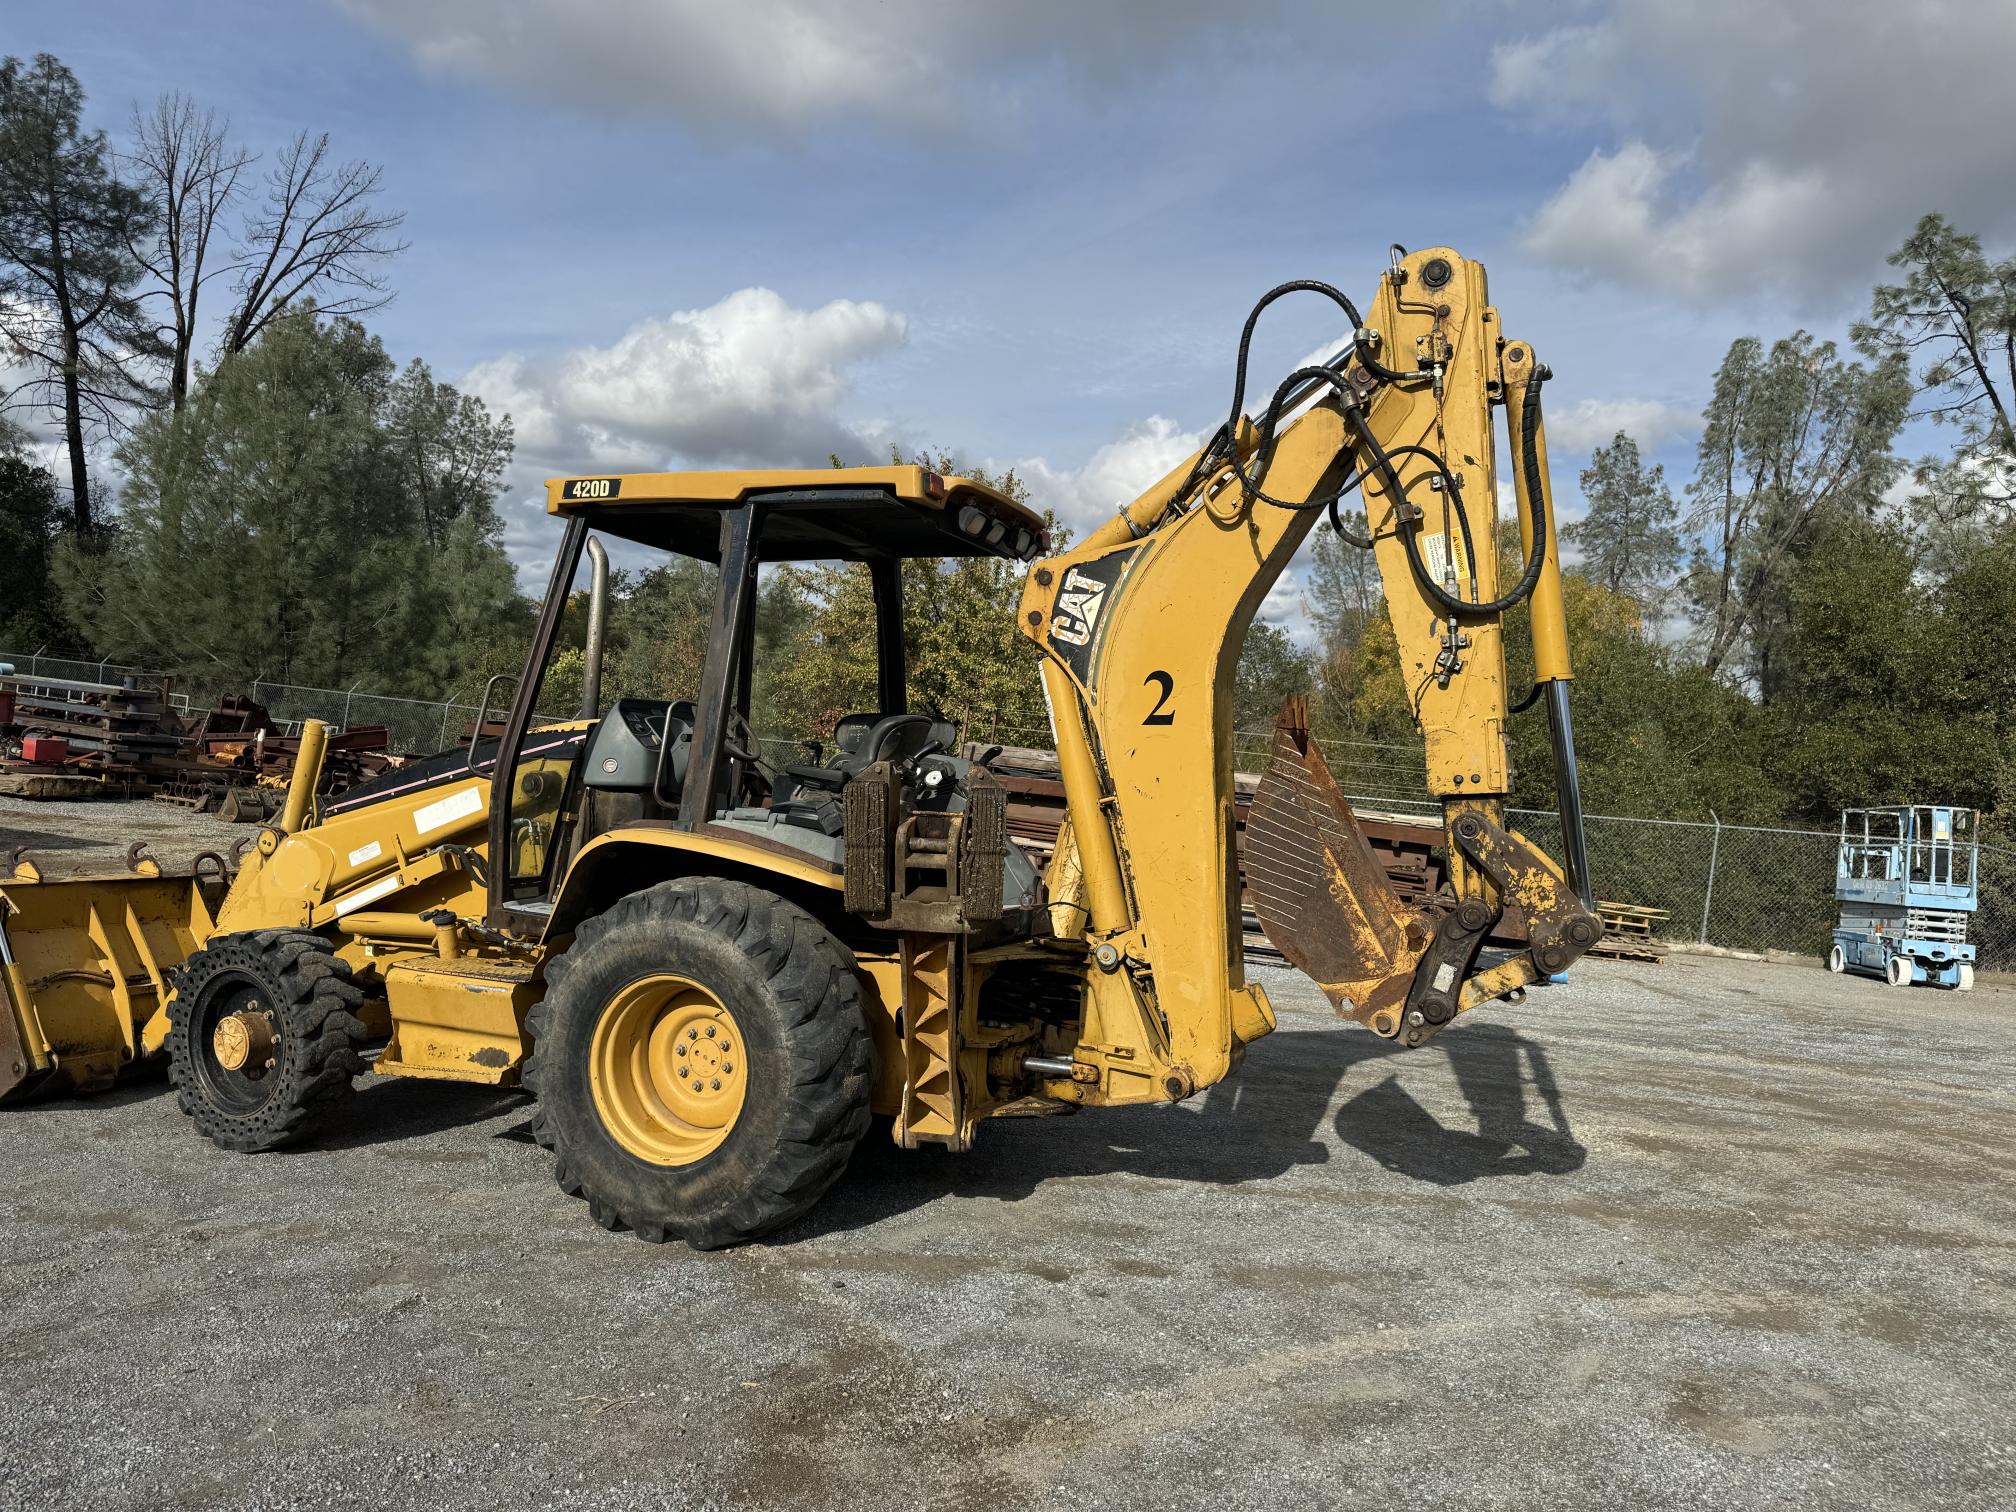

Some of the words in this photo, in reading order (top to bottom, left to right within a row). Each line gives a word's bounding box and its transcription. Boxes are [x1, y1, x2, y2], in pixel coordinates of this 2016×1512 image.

[572, 480, 610, 498] 420D
[1454, 543, 1465, 573] WARNING
[1051, 568, 1107, 646] CAT
[1141, 670, 1176, 726] 2
